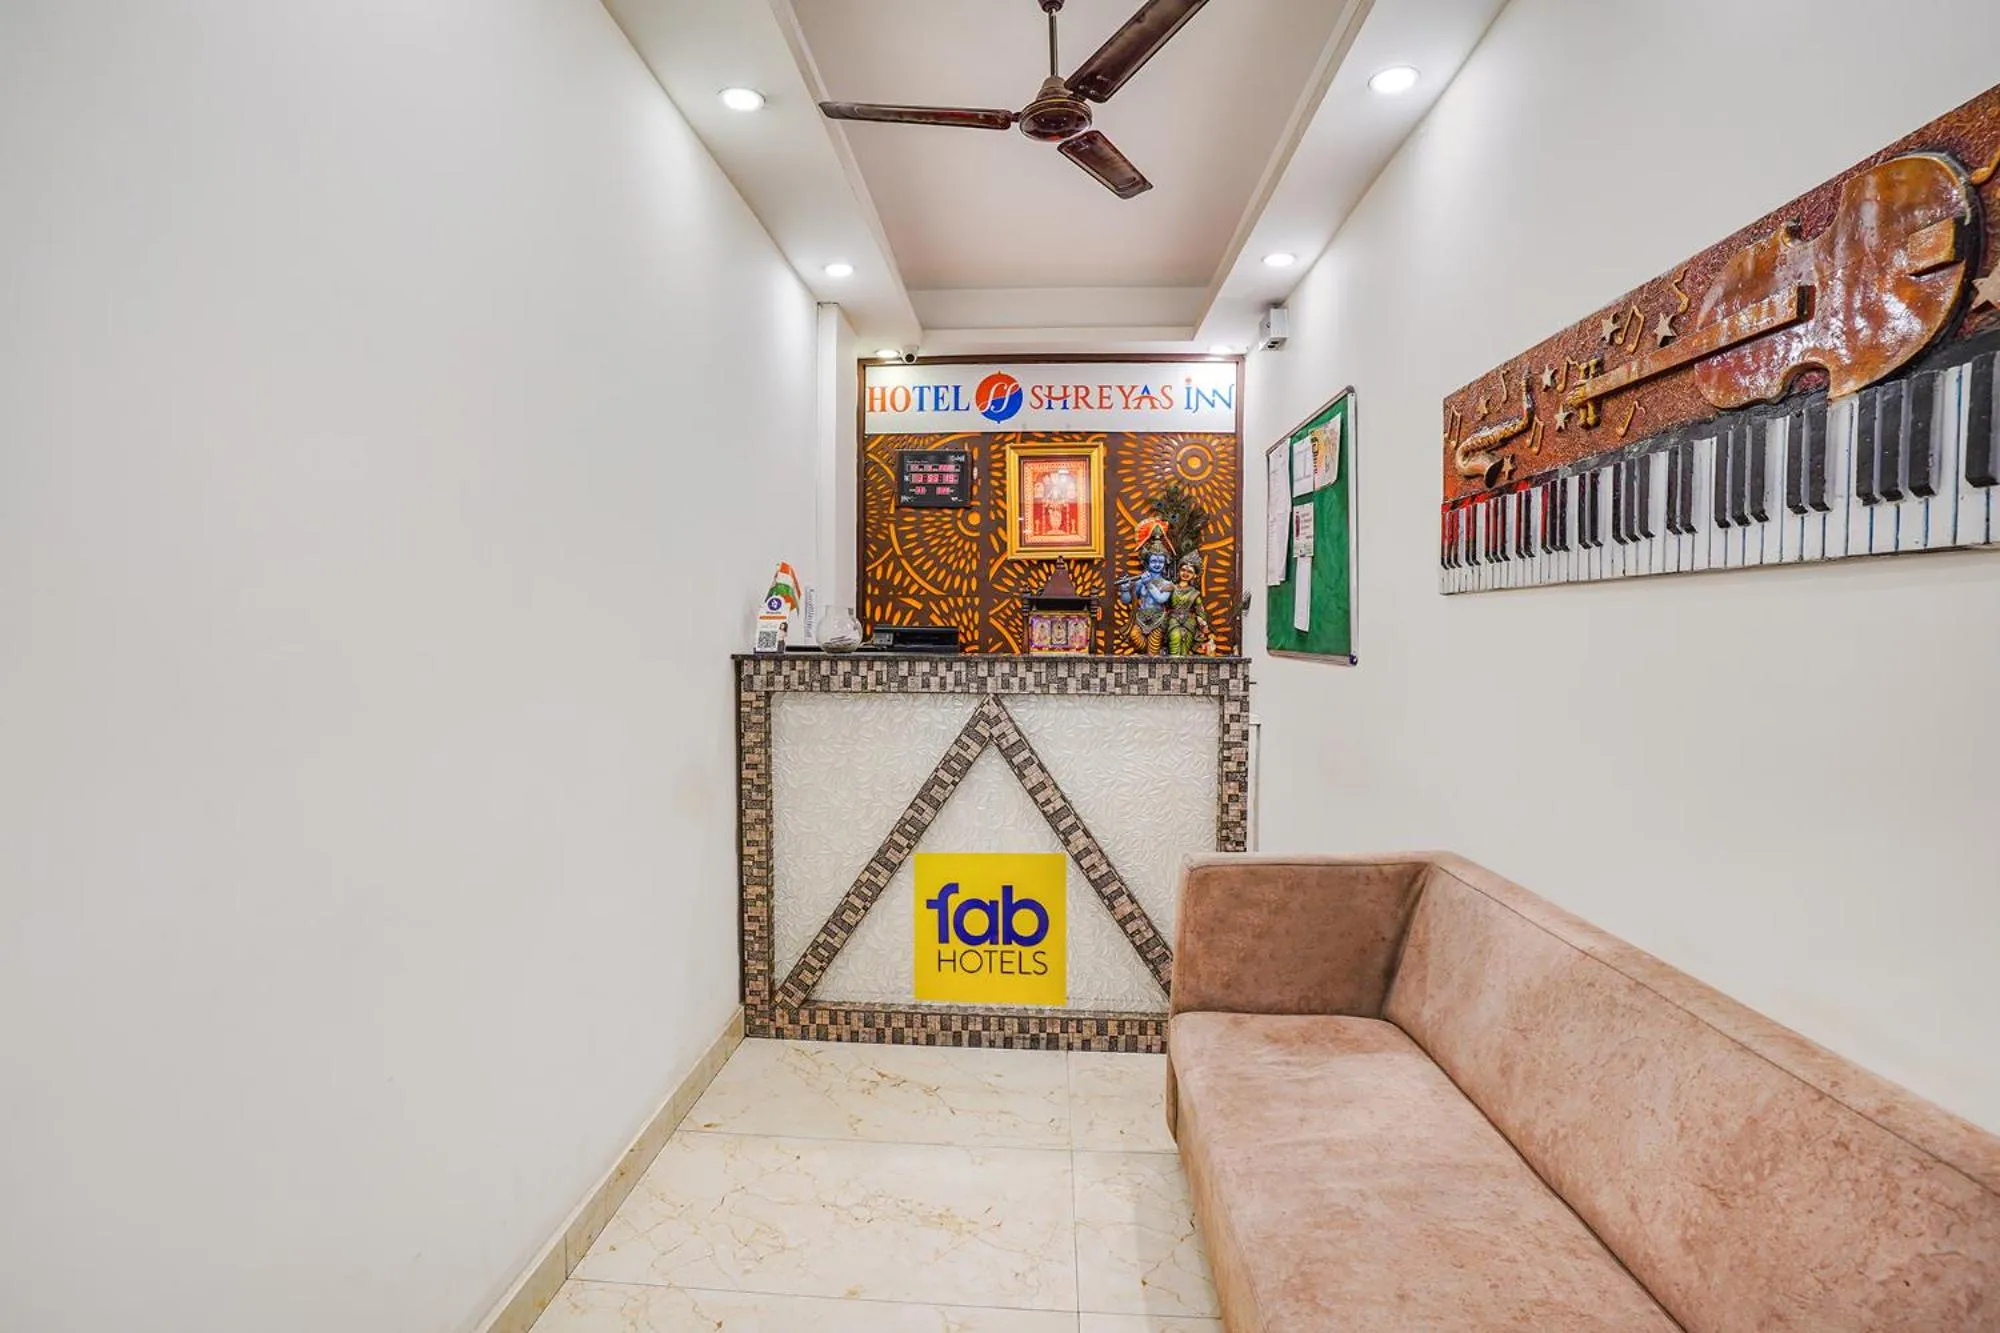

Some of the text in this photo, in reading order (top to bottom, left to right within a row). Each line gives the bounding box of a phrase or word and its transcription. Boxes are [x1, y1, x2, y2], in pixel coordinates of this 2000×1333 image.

[868, 385, 970, 412] HOTEL
[1029, 384, 1174, 411] SHREYAS
[926, 882, 1050, 947] fab
[938, 949, 1049, 976] HOTELS
